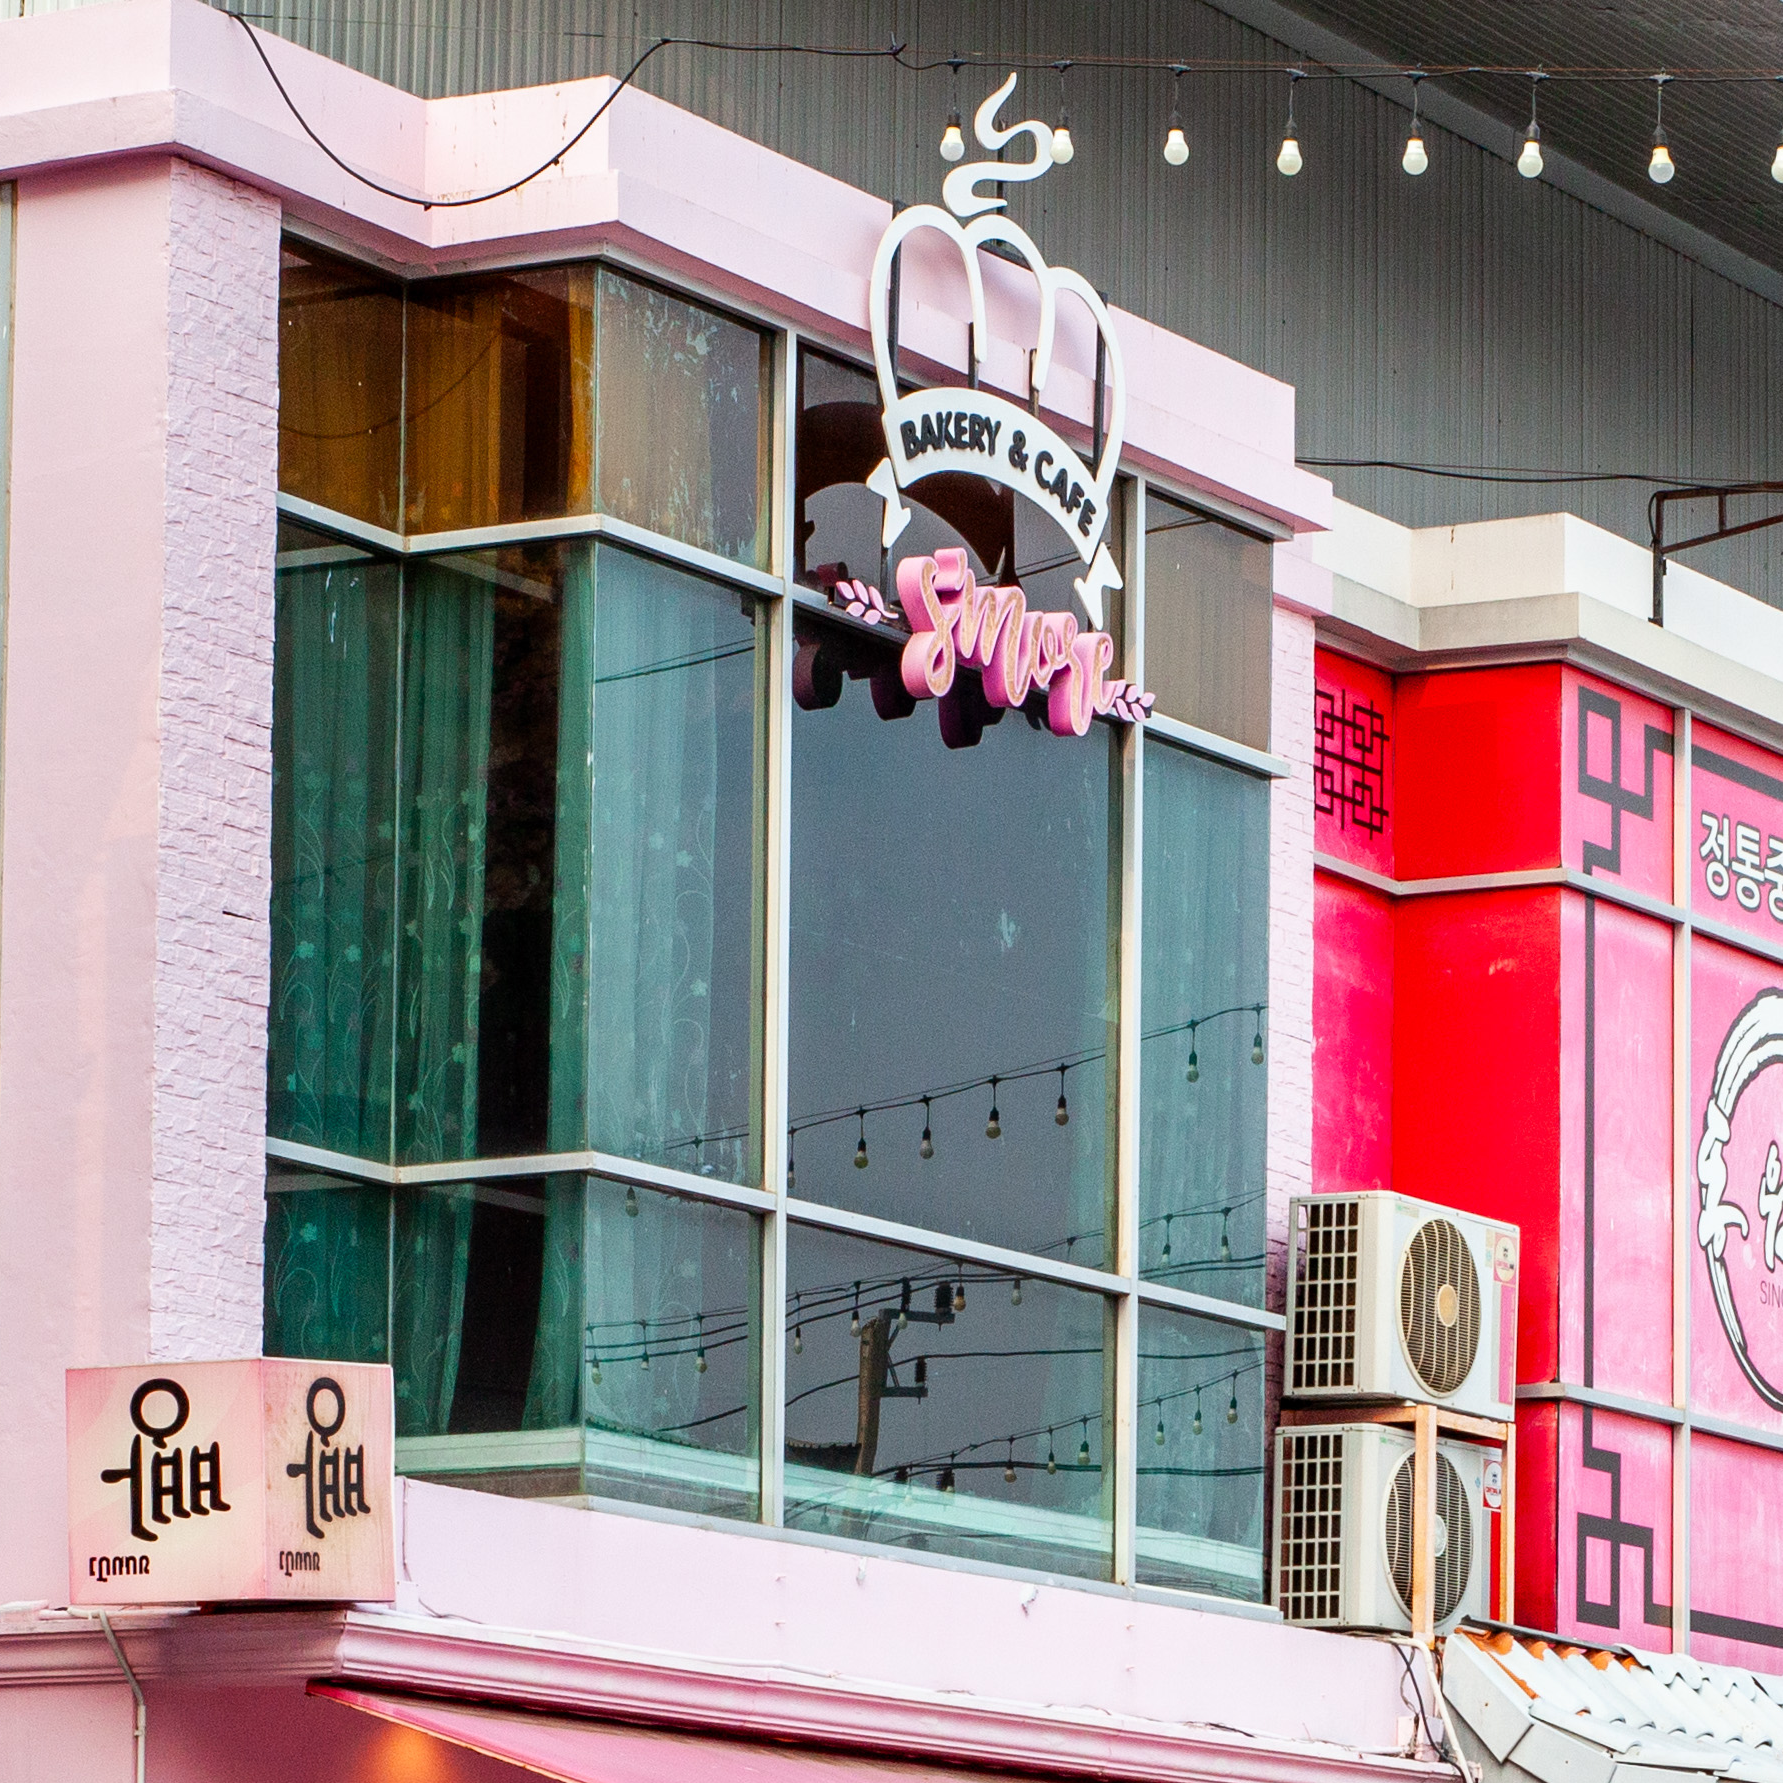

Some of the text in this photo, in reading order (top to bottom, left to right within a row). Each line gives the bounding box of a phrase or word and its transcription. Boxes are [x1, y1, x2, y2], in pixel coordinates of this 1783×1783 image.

[900, 412, 1098, 536] BAKERY & CAFE
